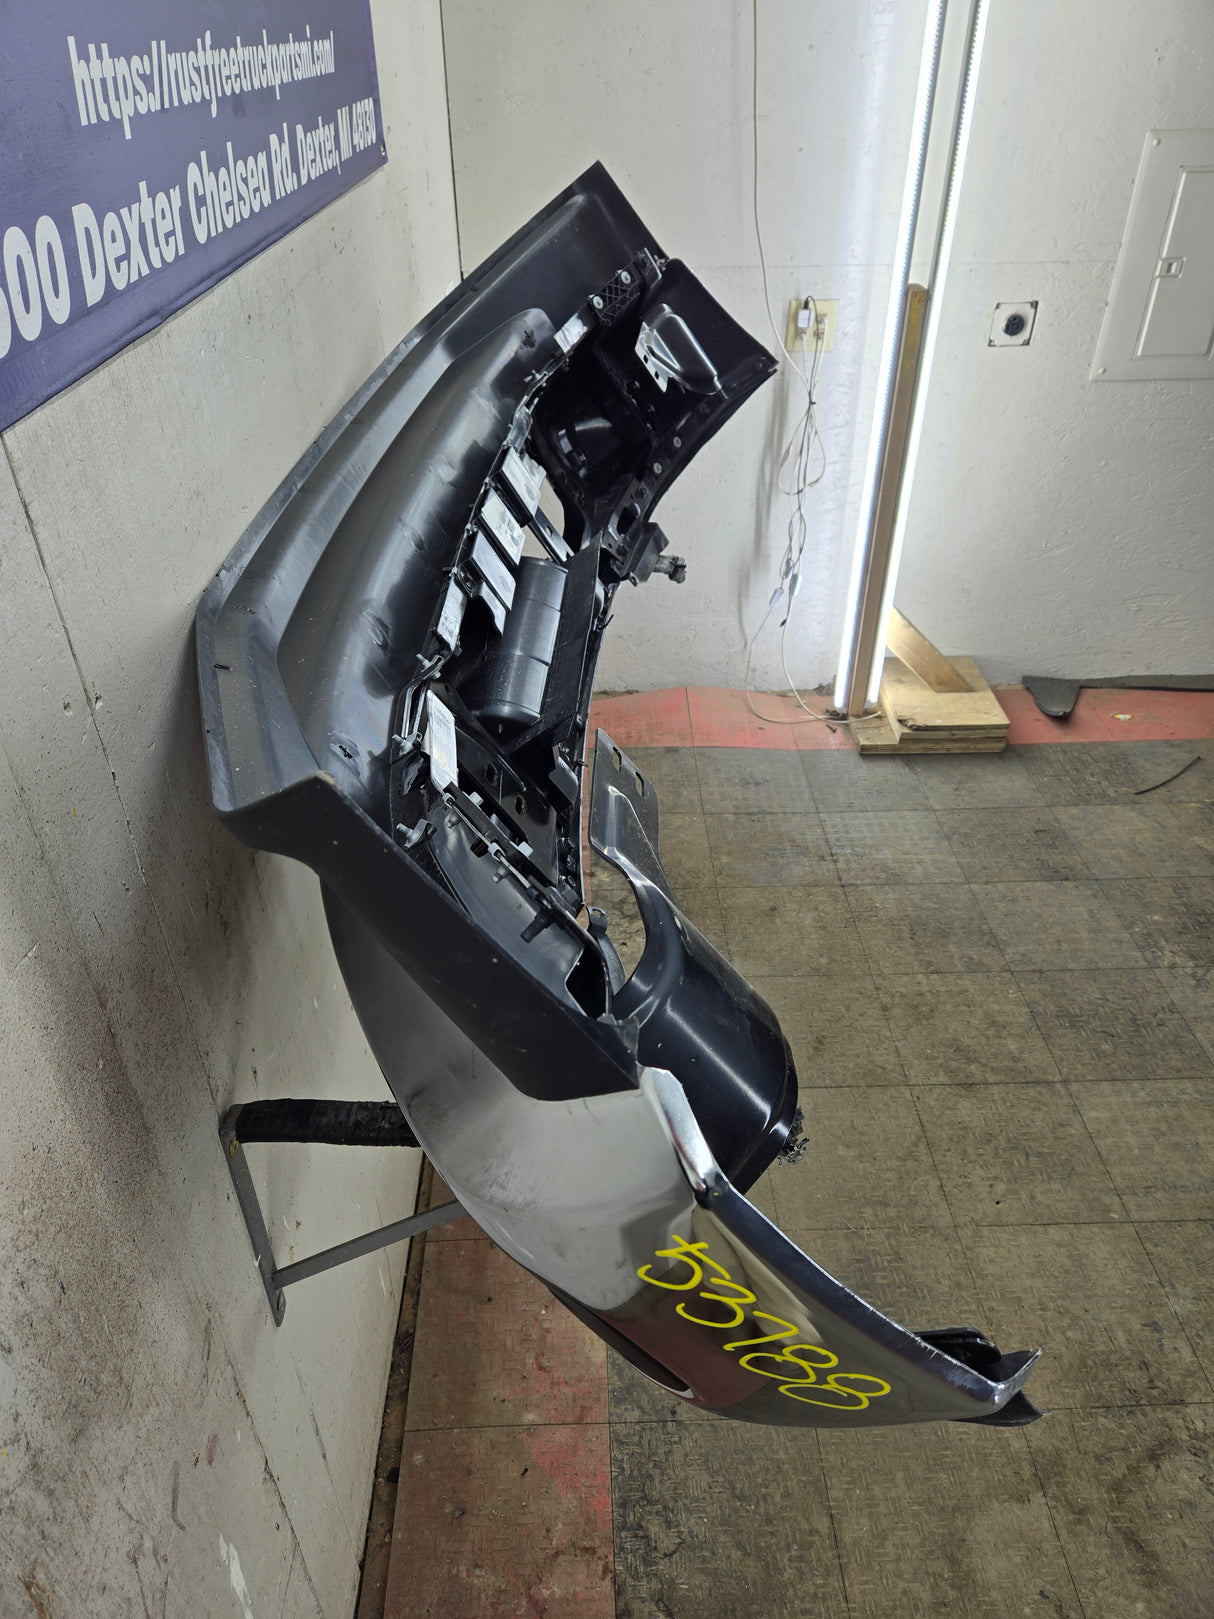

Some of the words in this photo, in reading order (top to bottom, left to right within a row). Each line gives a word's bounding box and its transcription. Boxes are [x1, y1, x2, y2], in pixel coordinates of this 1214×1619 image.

[66, 24, 335, 140] https://rustfreetruckpartsmi.com/
[0, 215, 71, 360] 00
[71, 179, 186, 308] Dexter
[186, 141, 272, 245] Chelsea
[269, 122, 298, 201] Rd.
[295, 115, 342, 186] Dexter,
[336, 105, 353, 162] MI
[352, 97, 377, 153] 48130
[637, 1234, 892, 1411] 53788
